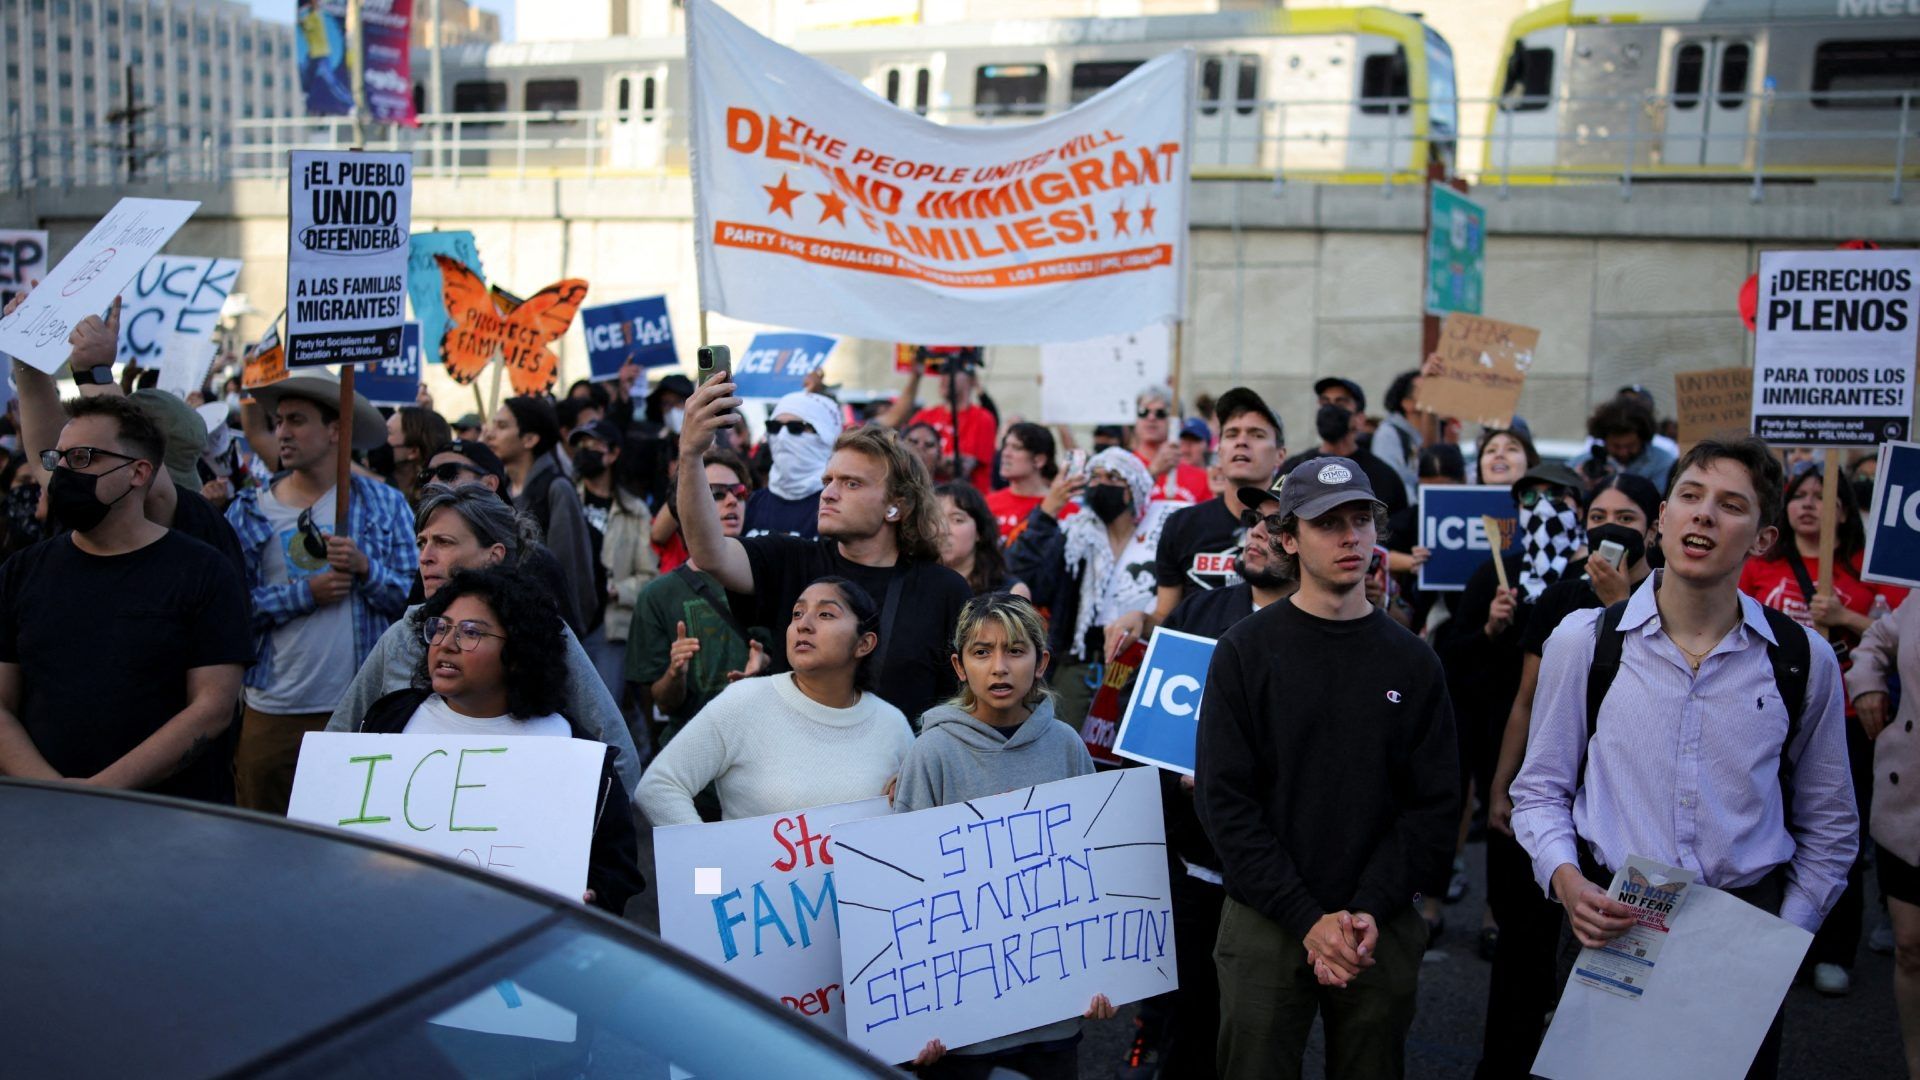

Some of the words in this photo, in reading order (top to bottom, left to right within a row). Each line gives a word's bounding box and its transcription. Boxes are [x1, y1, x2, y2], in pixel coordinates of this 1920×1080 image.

[786, 116, 847, 159] THE
[852, 148, 970, 184] PEOPLE
[972, 149, 1055, 183] UNITED
[1058, 129, 1125, 161] WILL
[304, 161, 333, 190] ¡EL
[338, 162, 405, 187] PUEBLO
[916, 142, 1180, 219] IMMIGRANT
[312, 189, 397, 226] UNIDO
[304, 223, 401, 251] DEFENDERÁ
[855, 203, 1099, 261] FAMILIES!
[723, 226, 777, 246] PARTY
[809, 243, 894, 267] SOCIALISM
[1008, 269, 1035, 283] LOS
[137, 259, 236, 304] UCK
[296, 280, 307, 297] A
[311, 278, 339, 296] LAS
[343, 275, 402, 295] FAMILIAS
[1770, 269, 1912, 296] ¡DERECHOS
[297, 296, 400, 322] MIGRANTES!
[1768, 299, 1908, 331] PLENOS
[295, 339, 315, 349] Party
[316, 338, 326, 348] for
[327, 336, 364, 347] Socialism
[364, 335, 377, 344] and
[466, 307, 540, 346] PROTECT
[587, 321, 625, 352] ICE
[295, 348, 331, 360] Liberation
[457, 330, 543, 373] FAMILIES
[740, 348, 780, 373] ICE
[1764, 368, 1809, 383] PARA
[1814, 368, 1869, 383] TODOS
[1874, 368, 1905, 384] LOS
[1762, 387, 1904, 406] INMIGRANTES!
[1760, 429, 1806, 439] Liberation
[1818, 430, 1875, 441] PSLWeb.org
[1761, 419, 1784, 430] Party
[1787, 419, 1799, 430] for
[1800, 420, 1844, 430] Socialism
[1846, 420, 1864, 430] and
[1426, 516, 1491, 550] ICE
[1140, 667, 1205, 721] IC
[338, 747, 509, 832] ICE
[938, 803, 1071, 878] STOP
[890, 848, 1101, 961] FAMILY
[1618, 892, 1637, 905] NO
[1639, 898, 1673, 914] FEAR
[1621, 880, 1642, 894] NO
[1644, 886, 1681, 904] HATE
[711, 871, 841, 963] FAM
[866, 908, 1171, 1033] SEPARATION
